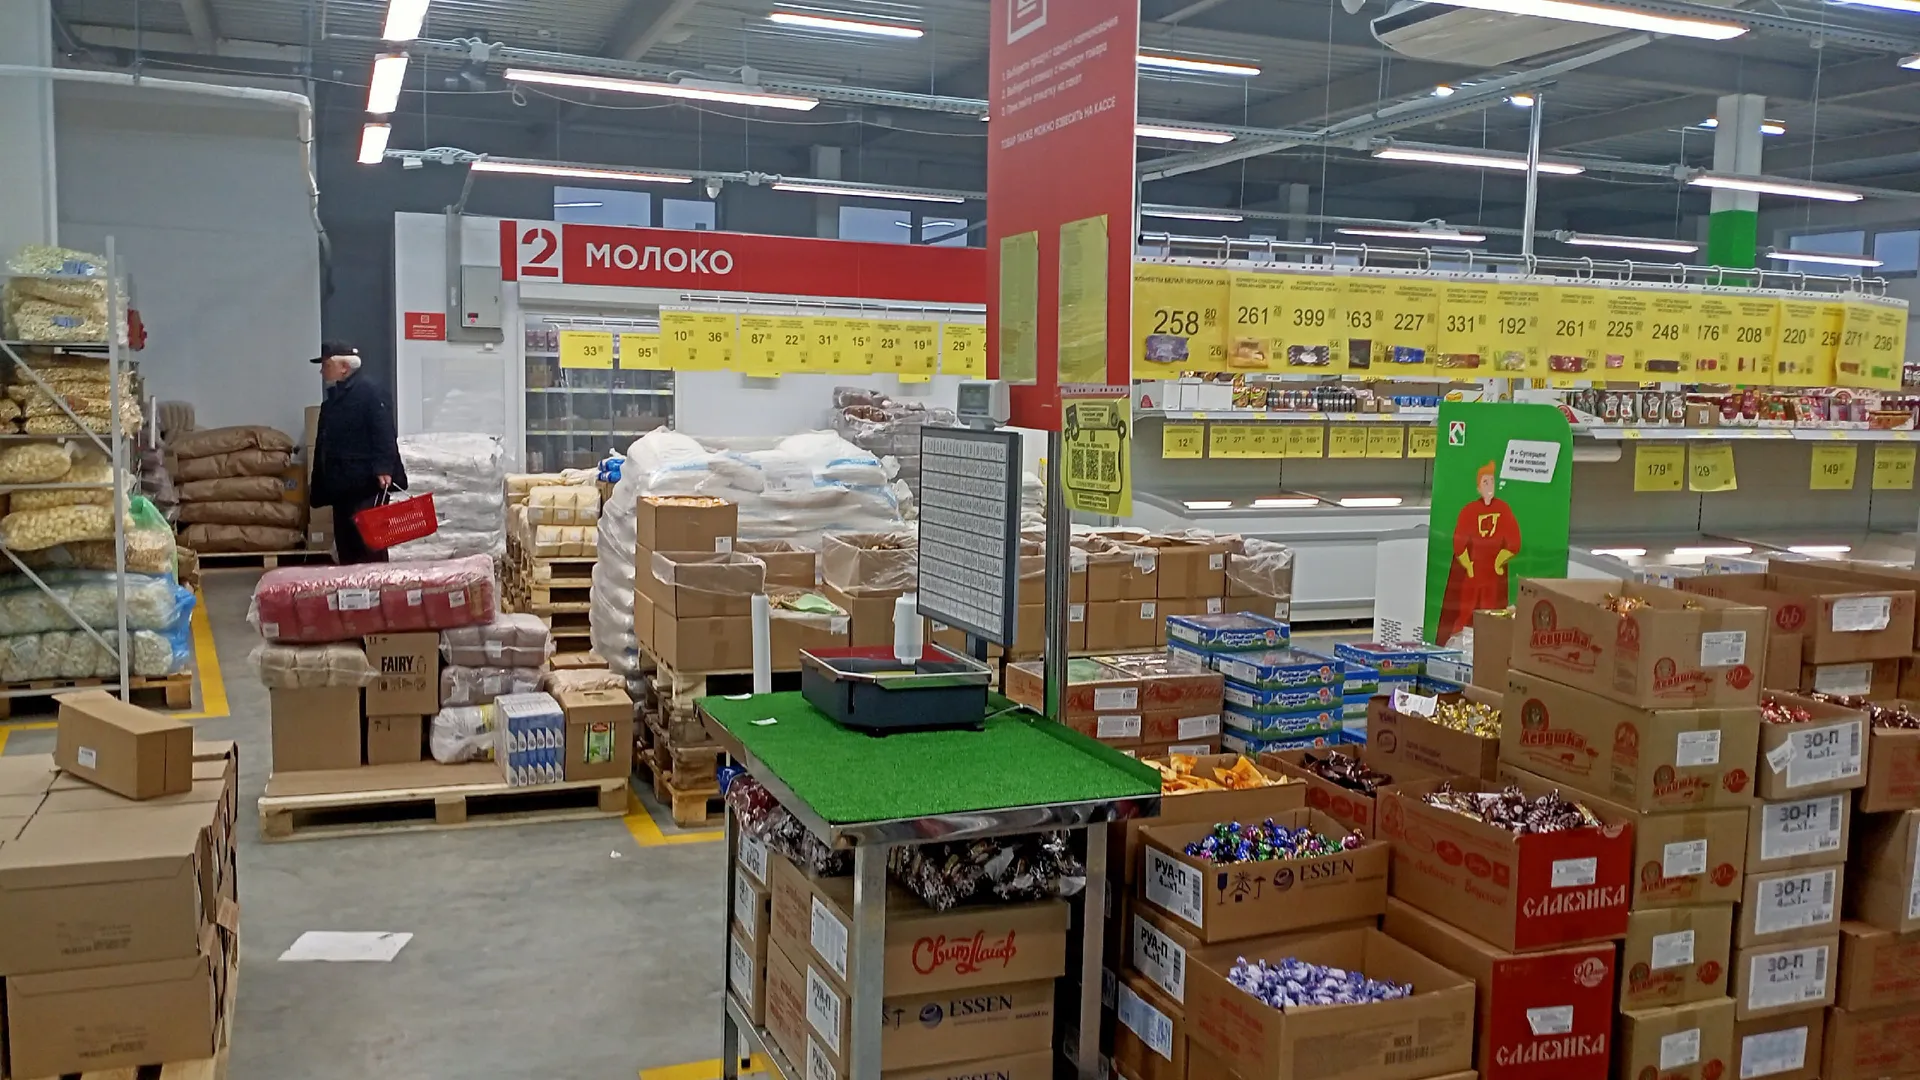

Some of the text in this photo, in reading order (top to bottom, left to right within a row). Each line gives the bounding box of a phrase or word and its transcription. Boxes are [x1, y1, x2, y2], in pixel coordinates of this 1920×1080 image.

[1083, 105, 1093, 118] НА
[1094, 96, 1116, 112] КАССЕ
[521, 228, 734, 275] 2 МОЛОКО
[1204, 308, 1216, 319] 80
[1238, 306, 1268, 325] 261
[1293, 308, 1325, 327] 399
[1153, 310, 1199, 335] 258
[1394, 313, 1424, 331] 227
[1447, 315, 1474, 332] 331
[1499, 317, 1526, 334] 192
[1556, 320, 1584, 337] 261
[1607, 321, 1633, 337] 225
[674, 331, 687, 341] 10
[708, 332, 722, 343] 36
[751, 334, 764, 344] 87
[1652, 323, 1679, 340] 248
[1737, 327, 1762, 343] 208
[1783, 328, 1806, 344] 220
[1845, 330, 1862, 347] 271
[785, 335, 798, 345] 22
[818, 335, 831, 345] 31
[852, 337, 864, 347] 15
[881, 338, 894, 349] 23
[914, 340, 925, 350] 19
[952, 341, 965, 351] 29
[1873, 335, 1892, 351] 236
[584, 346, 597, 356] 33
[638, 348, 652, 358] 95
[1210, 346, 1221, 356] 26
[1178, 438, 1188, 447] 12
[1417, 439, 1430, 447] 175
[1648, 464, 1665, 476] 179
[1823, 463, 1838, 475] 149
[381, 655, 415, 673] FAIRY
[1155, 857, 1187, 886] РУА-П
[1300, 859, 1354, 880] ESSEN
[1523, 884, 1625, 919] СЛАВЯНКА
[1140, 926, 1168, 958] РУА-П
[950, 994, 1012, 1017] ESSEN
[1496, 1034, 1605, 1066] СЛАВЯНКА
